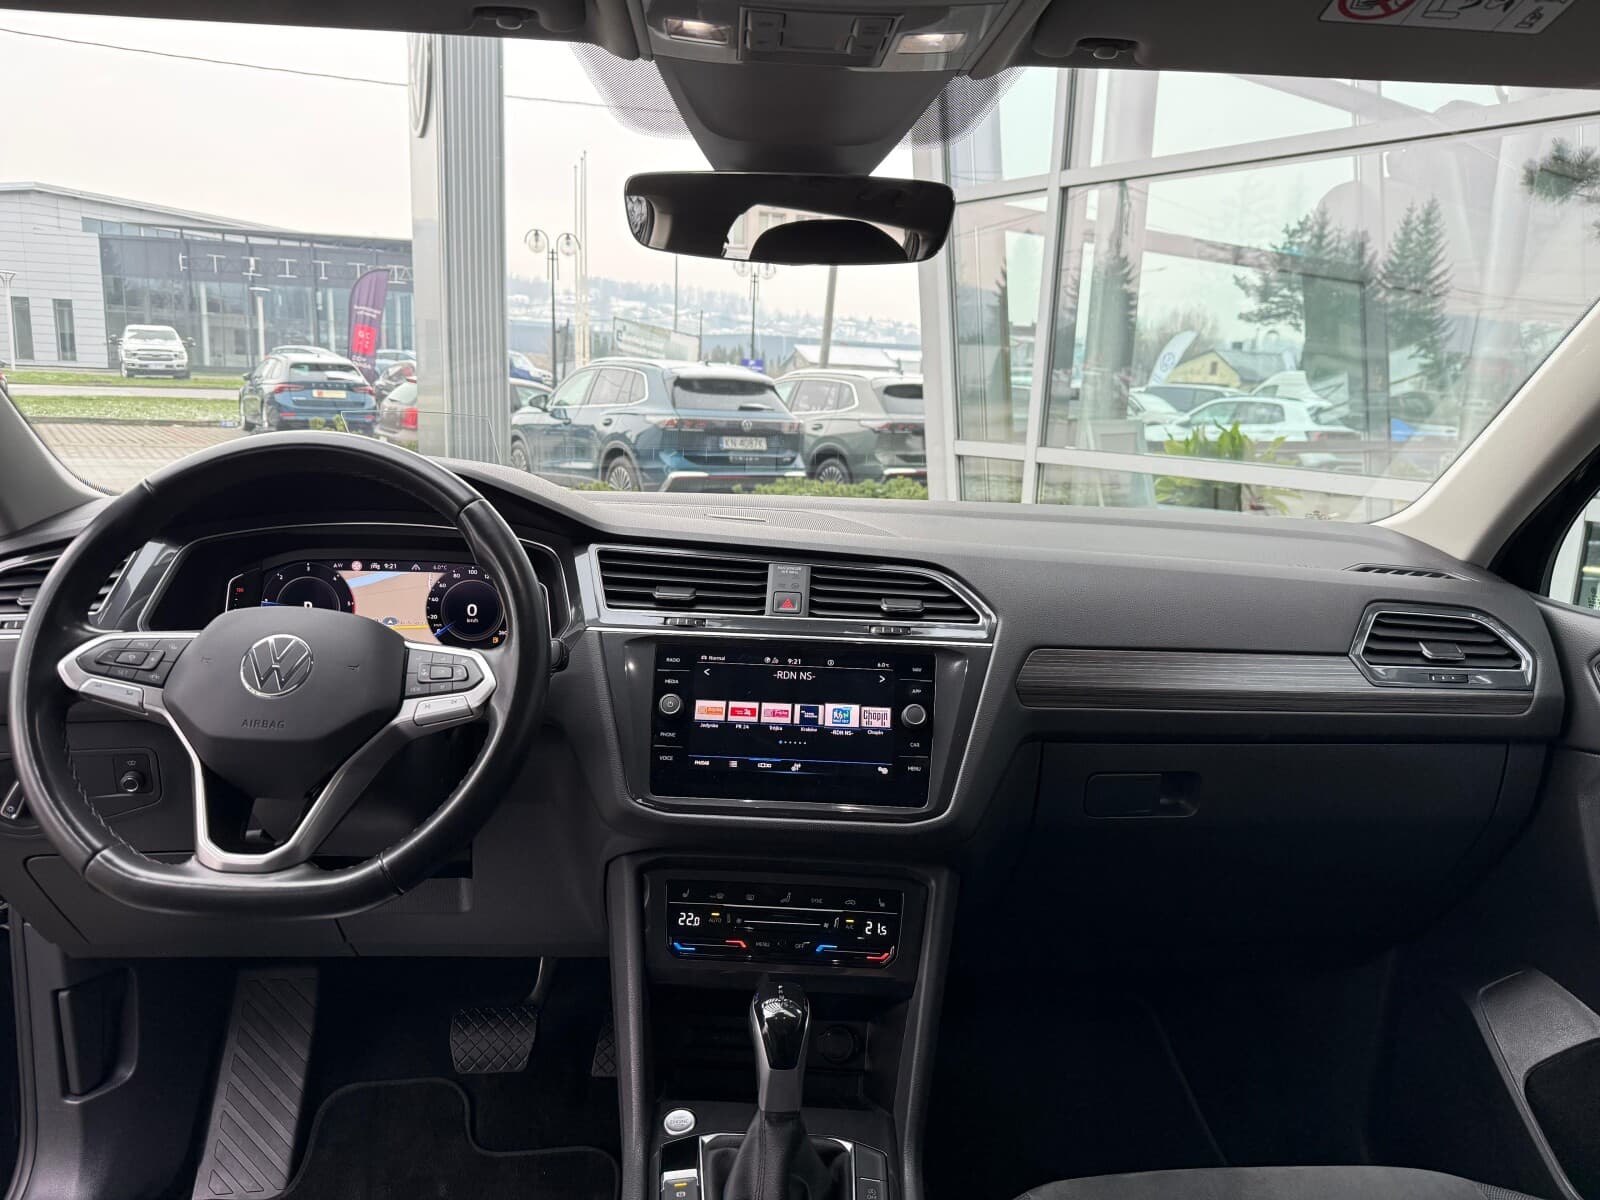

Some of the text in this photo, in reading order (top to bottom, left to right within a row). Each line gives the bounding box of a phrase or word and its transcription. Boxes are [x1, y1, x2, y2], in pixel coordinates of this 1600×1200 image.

[467, 604, 478, 617] 0
[773, 671, 816, 681] -RDN NS-
[863, 709, 888, 721] Chopin
[241, 718, 285, 729] AIRBAG
